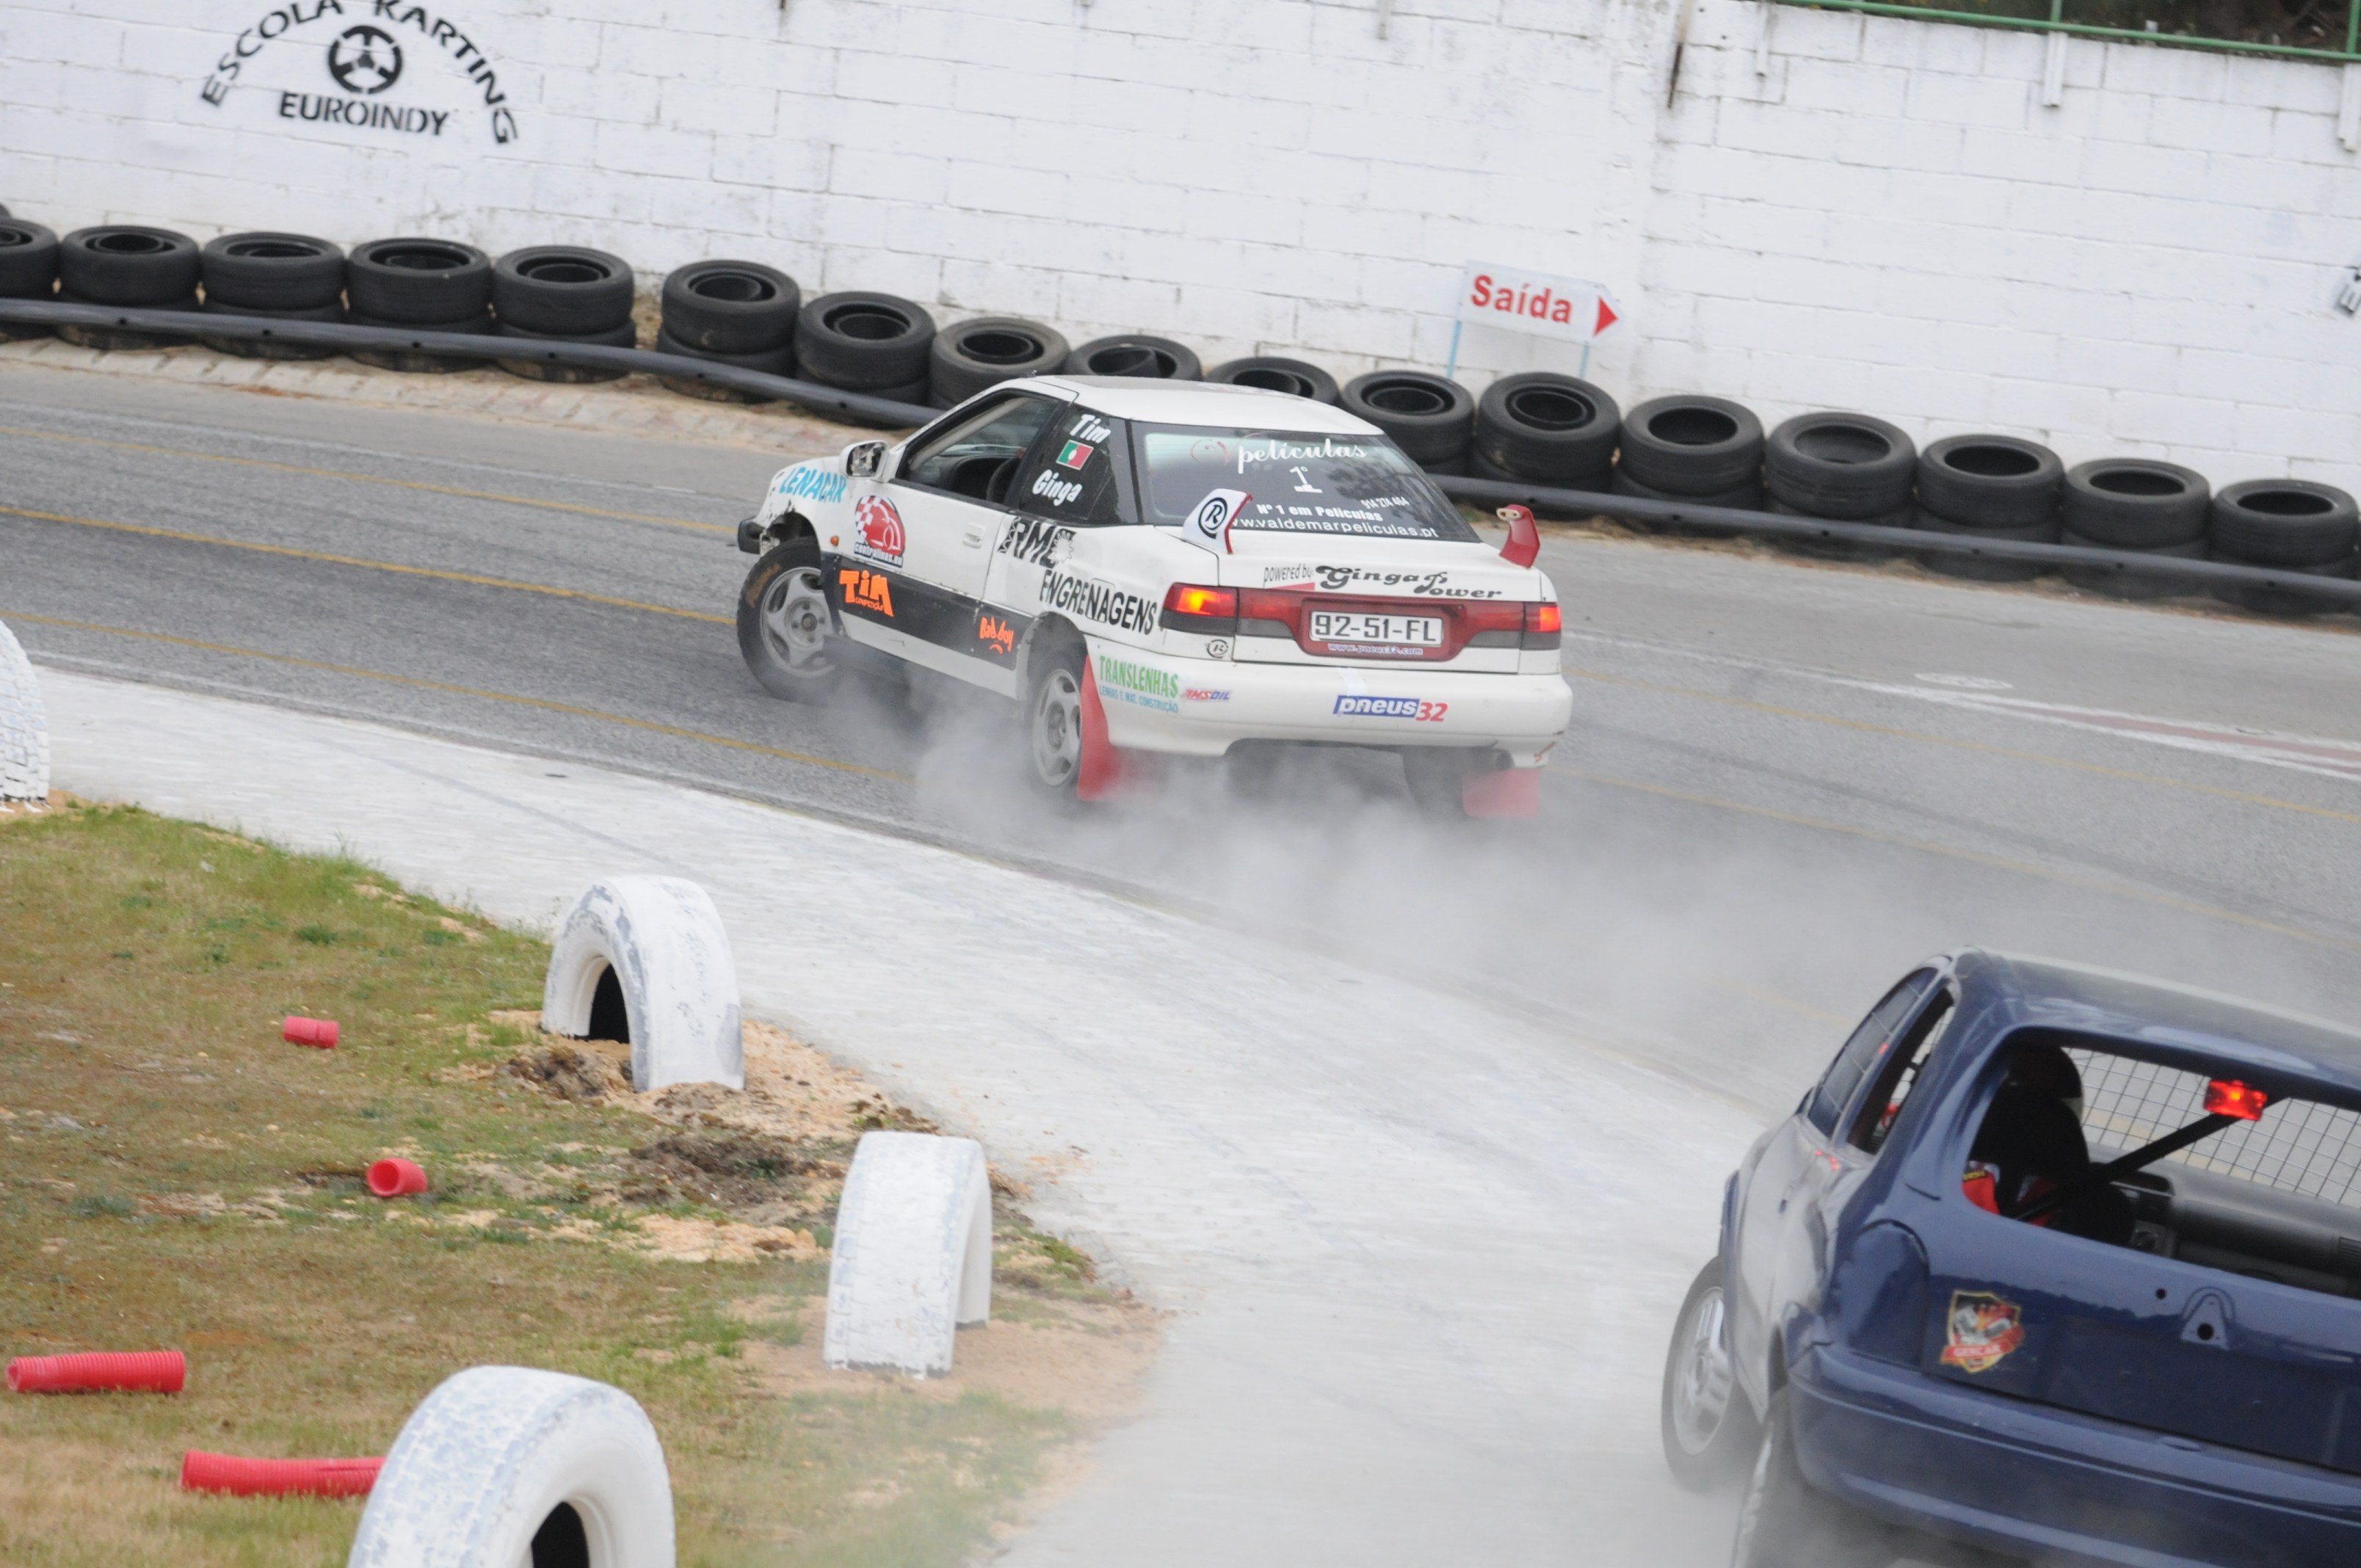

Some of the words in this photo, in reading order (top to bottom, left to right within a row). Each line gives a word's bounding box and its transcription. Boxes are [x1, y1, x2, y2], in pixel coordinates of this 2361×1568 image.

[202, 0, 344, 107] ESCOLA
[374, 0, 519, 145] KARTING
[279, 90, 449, 136] EUROINDY
[1470, 274, 1573, 324] Saída
[1070, 413, 1111, 444] Tim
[780, 466, 846, 503] LENACAR
[1032, 468, 1083, 506] Ginga
[1275, 504, 1285, 515] 1
[1288, 506, 1313, 516] em
[1263, 563, 1302, 589] powered
[1316, 565, 1419, 590] Ginga
[1414, 571, 1503, 599] Power
[1040, 569, 1158, 636] ENGRENAGENS
[1315, 614, 1437, 642] 92-51-FL
[1327, 643, 1424, 656] www.pneus32.com
[1100, 656, 1179, 698] TRANSLENHAS
[1100, 685, 1118, 699] LENHAS
